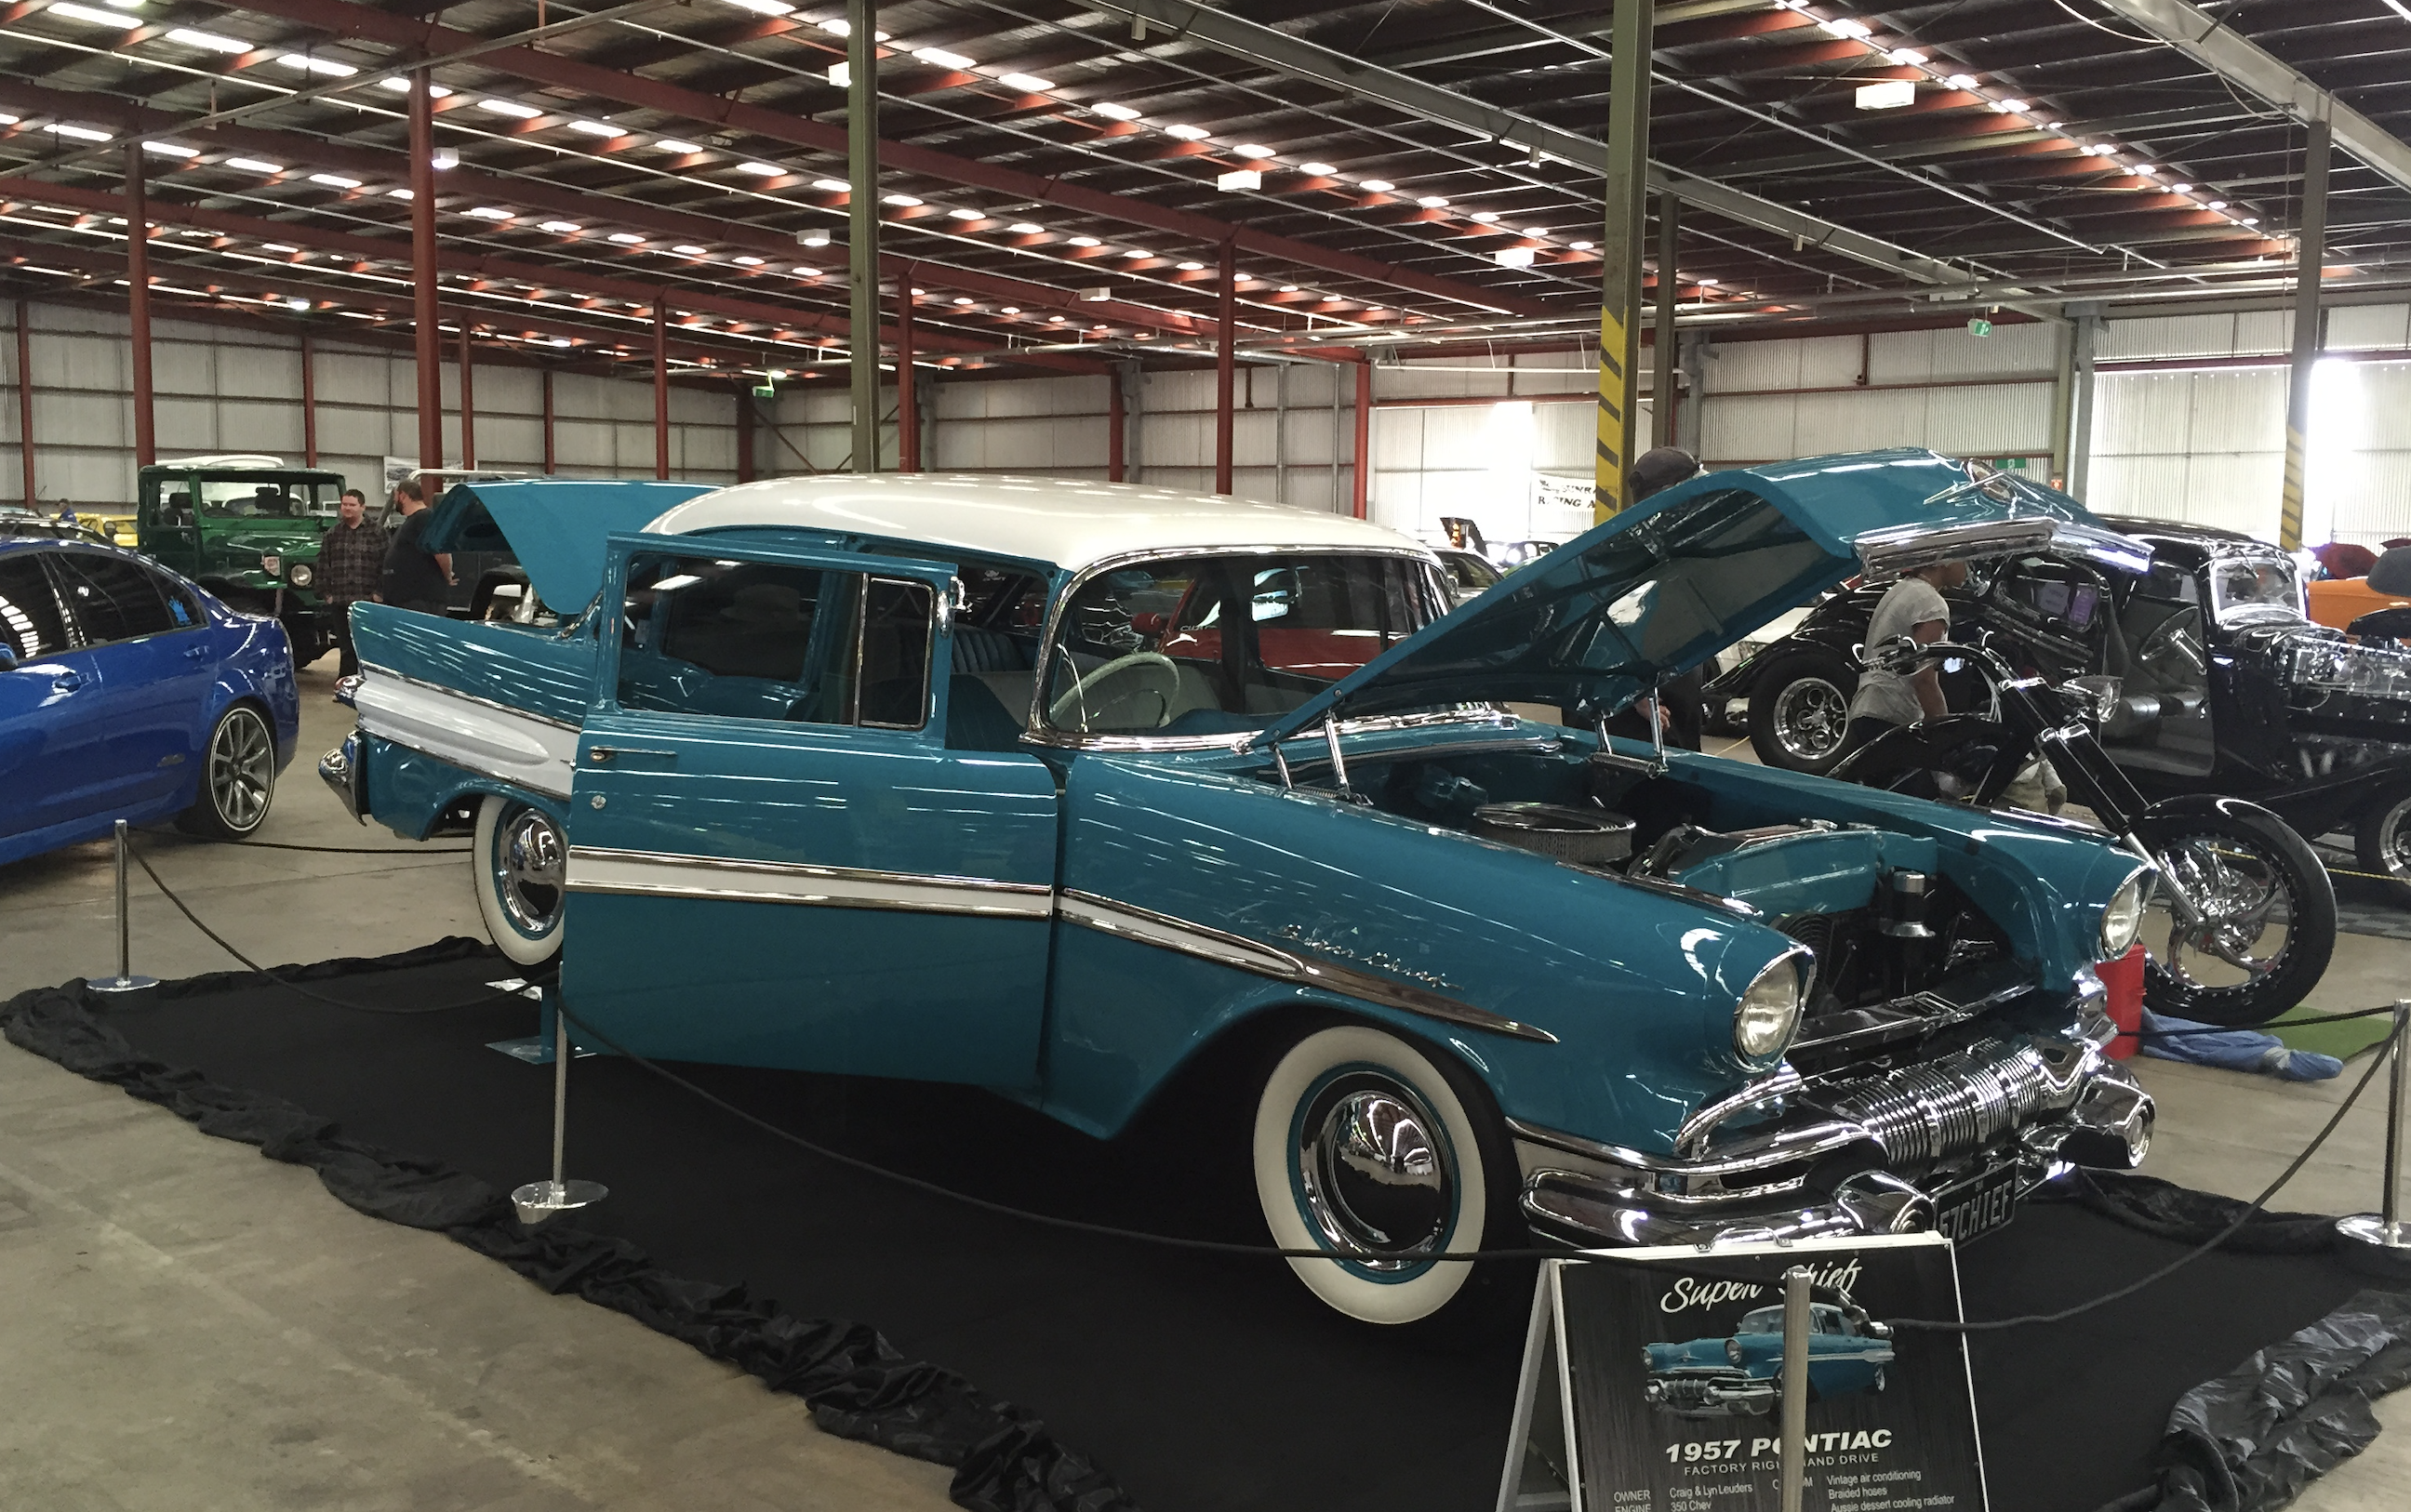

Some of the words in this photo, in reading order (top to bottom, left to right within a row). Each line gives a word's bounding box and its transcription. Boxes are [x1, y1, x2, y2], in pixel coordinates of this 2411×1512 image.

[1660, 1277, 1764, 1314] Super
[1666, 1439, 1742, 1463] 1957
[1684, 1463, 1747, 1477] FACTORY
[1752, 1459, 1780, 1472] RIG
[1803, 1453, 1835, 1467] AND
[1839, 1452, 1880, 1465] DRIVE
[1826, 1473, 1858, 1487] Vintage
[1859, 1472, 1871, 1483] air
[1872, 1469, 1922, 1482] conditioning
[1613, 1489, 1652, 1503] OWNER
[1669, 1485, 1694, 1499] Craig
[1695, 1485, 1702, 1496] &
[1703, 1484, 1718, 1498] Lyn
[1828, 1487, 1861, 1500] Braided
[1862, 1485, 1887, 1497] hoses
[1614, 1503, 1652, 1512] ENGINE
[1670, 1501, 1687, 1512] 350
[1688, 1499, 1712, 1511] Chev
[1831, 1500, 1859, 1512] Aussie
[1860, 1497, 1892, 1510] dessert
[1893, 1496, 1923, 1510] cooling
[1924, 1494, 1955, 1506] radiator
